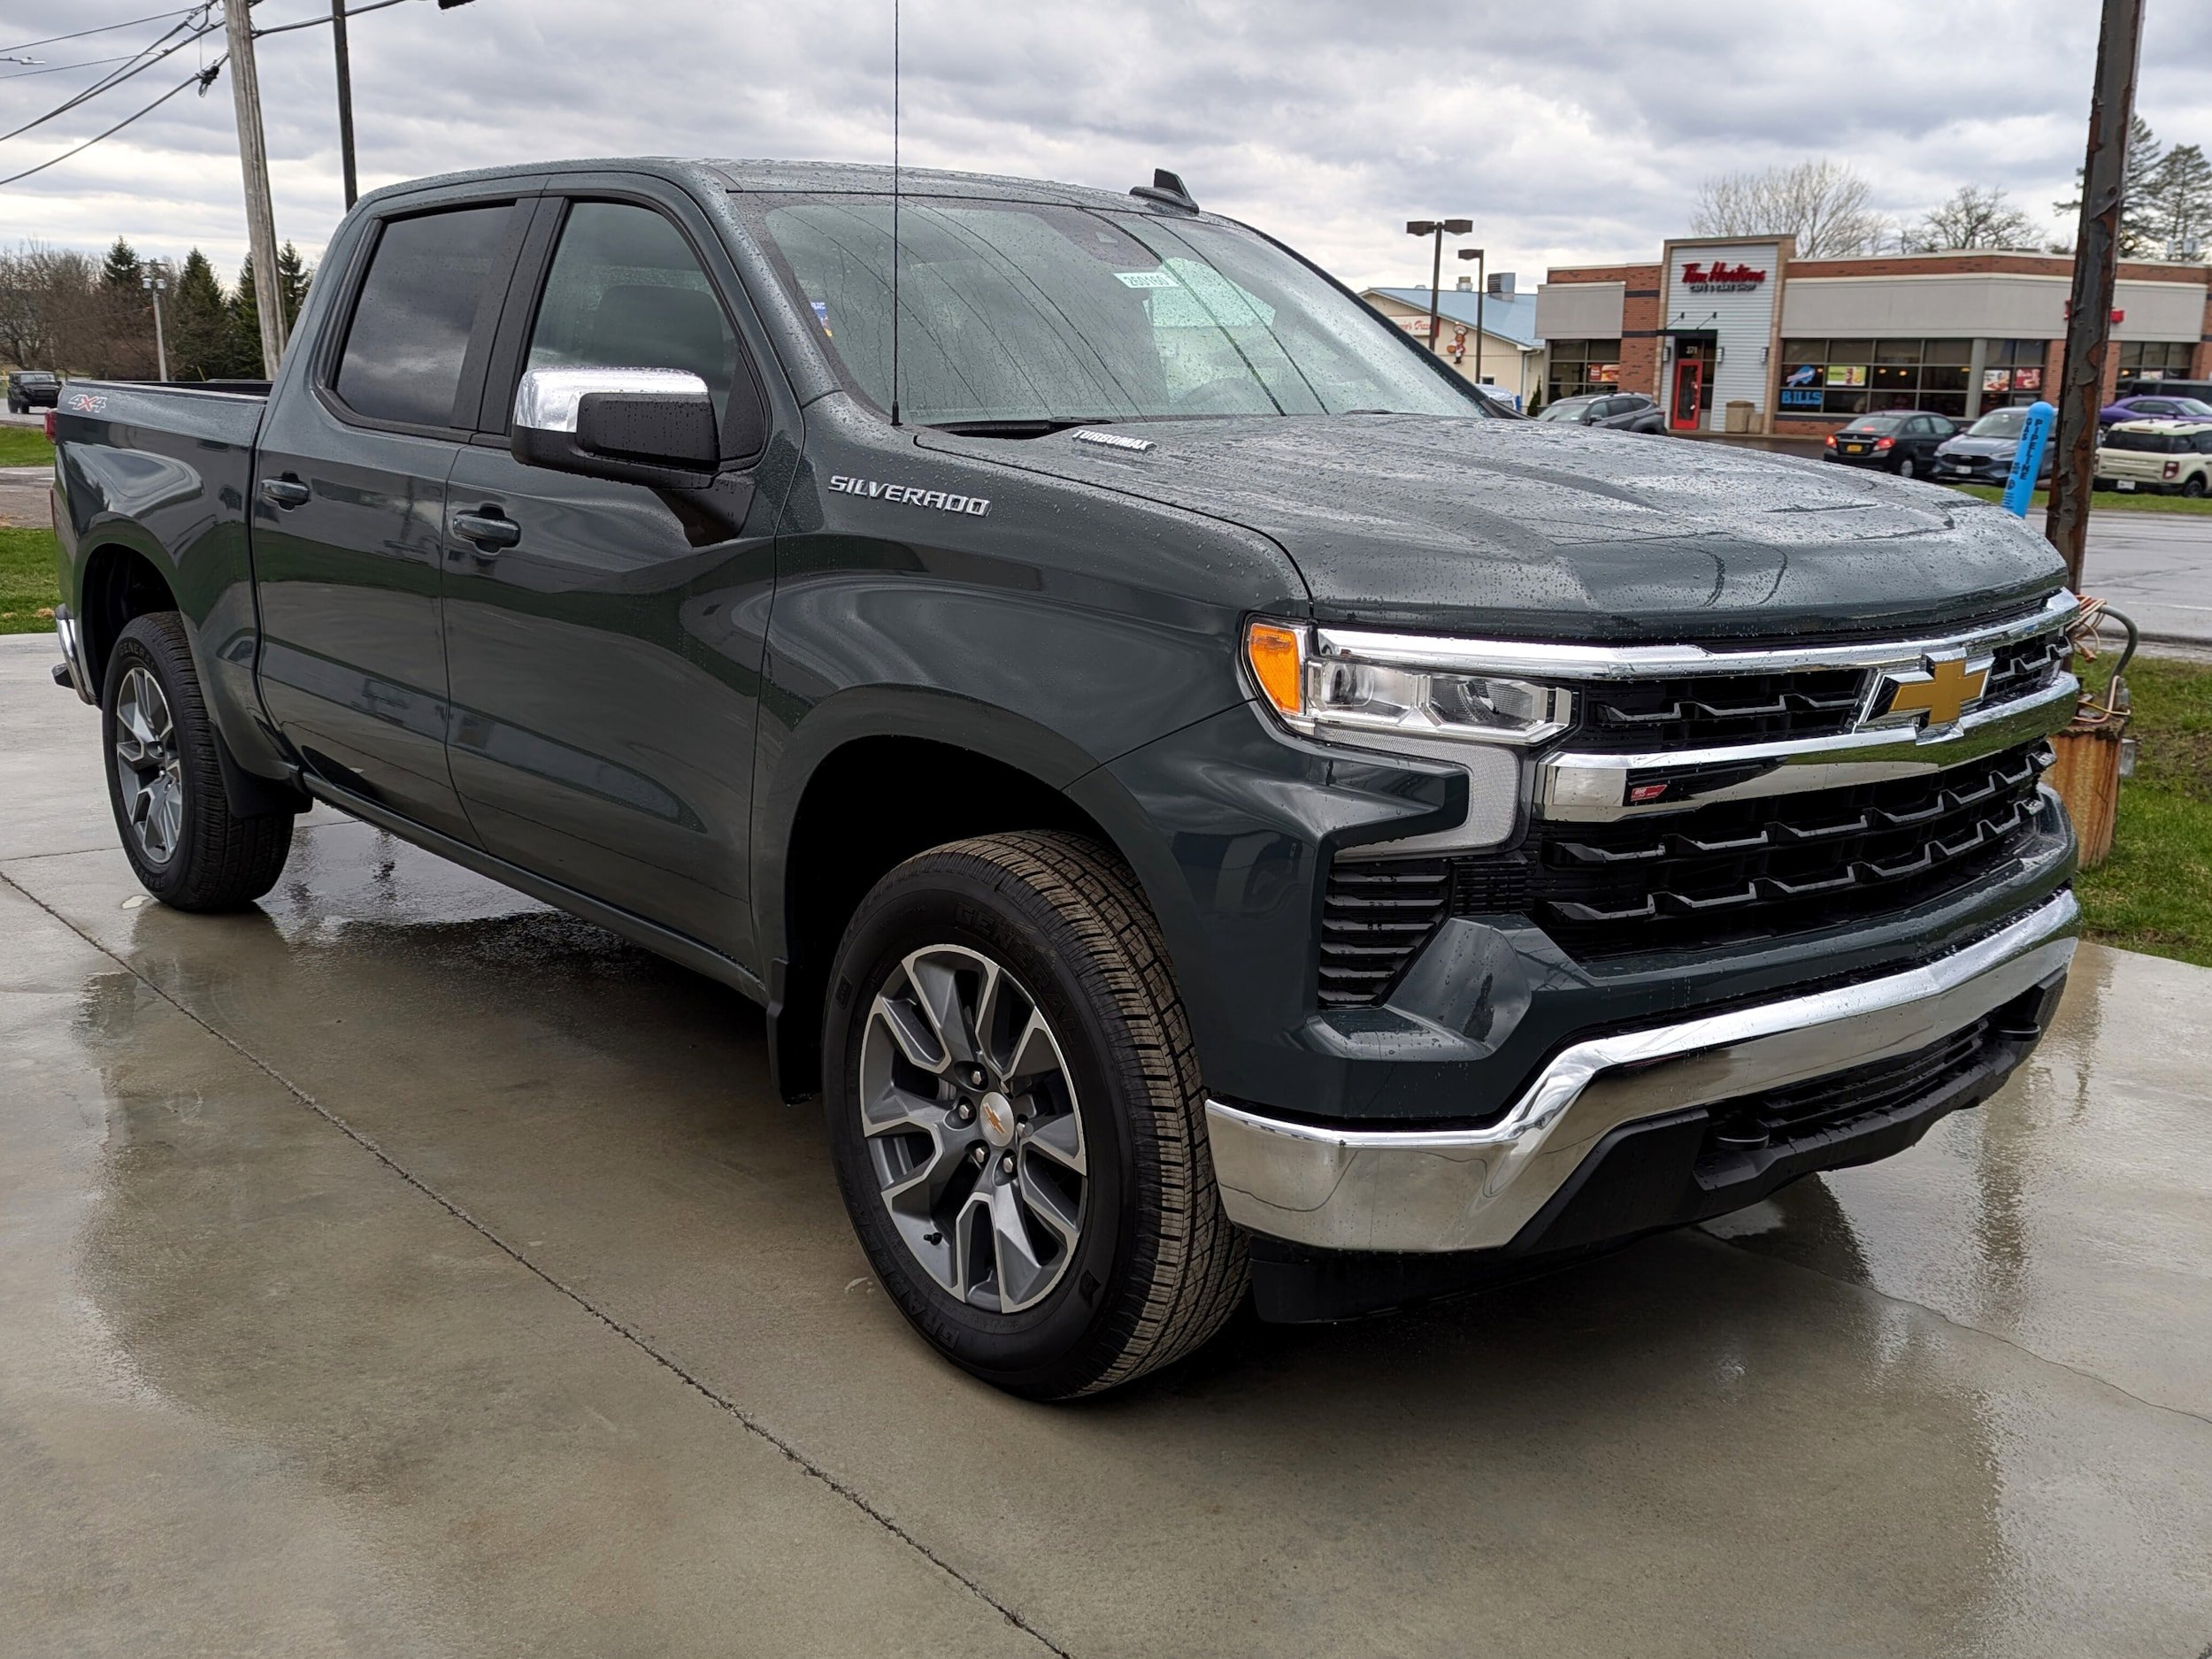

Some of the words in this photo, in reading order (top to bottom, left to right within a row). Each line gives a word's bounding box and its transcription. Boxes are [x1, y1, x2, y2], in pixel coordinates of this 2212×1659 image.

[1124, 275, 1170, 286] 260160
[1682, 263, 1708, 284] Tim
[1708, 261, 1766, 283] Hortons
[1781, 391, 1822, 404] BILLS
[1071, 429, 1154, 450] TURBOMAX
[2021, 417, 2033, 442] GAS
[2019, 419, 2044, 480] PIPELINE
[828, 475, 992, 517] SILVERADO
[954, 901, 1077, 1049] GENERAL
